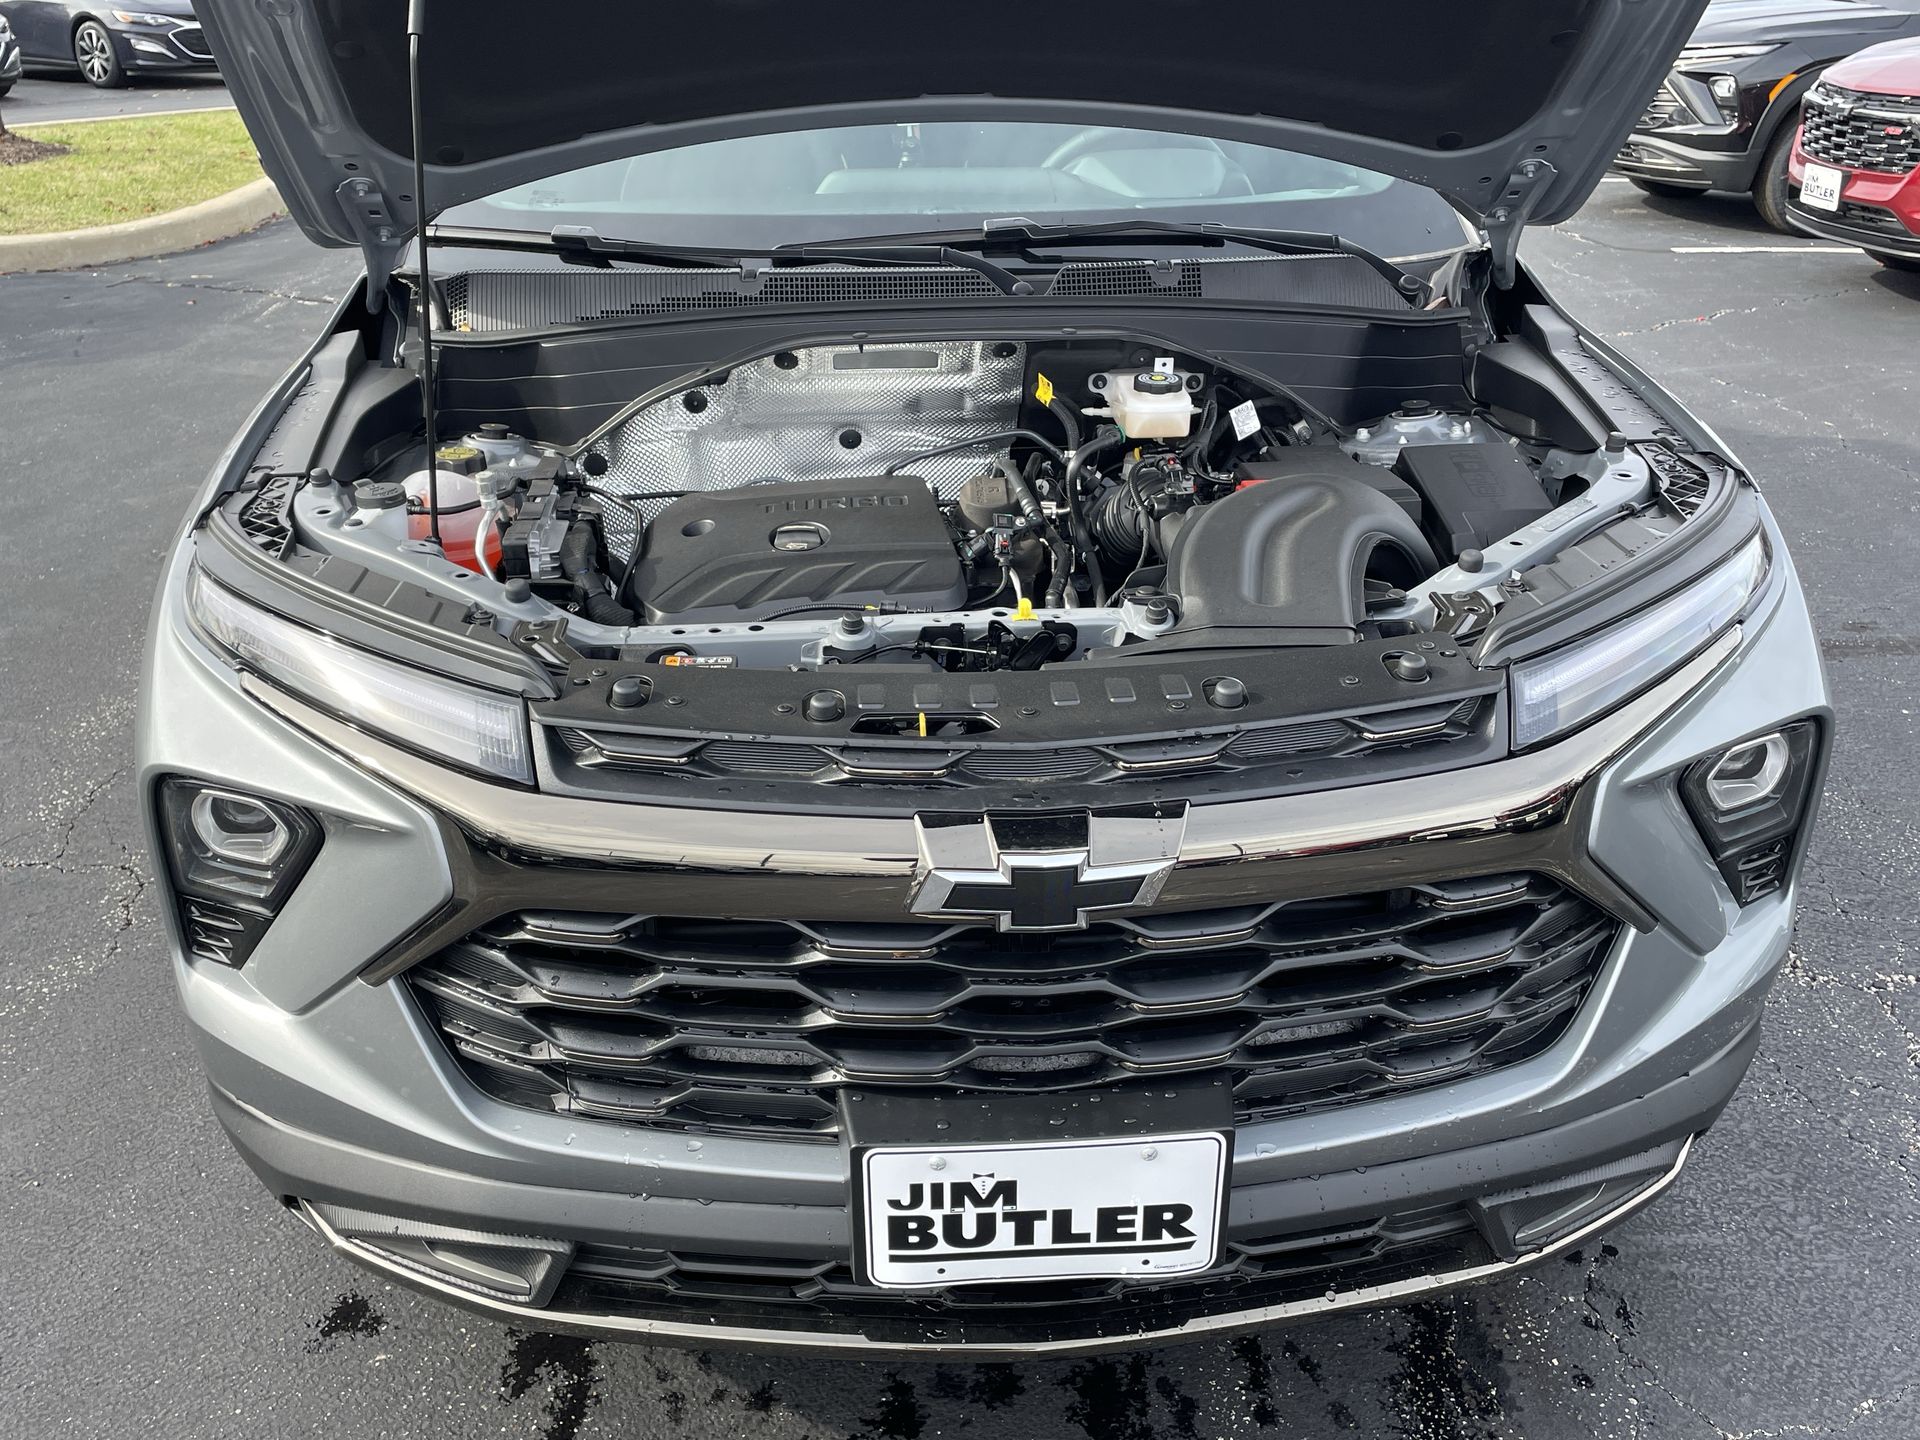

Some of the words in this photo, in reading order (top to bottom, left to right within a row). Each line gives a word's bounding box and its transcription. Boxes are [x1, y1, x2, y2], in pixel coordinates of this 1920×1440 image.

[1804, 182, 1835, 199] BUTLER
[757, 495, 909, 514] TURBO
[887, 1179, 1018, 1214] JIM
[887, 1203, 1198, 1252] BUTLER
